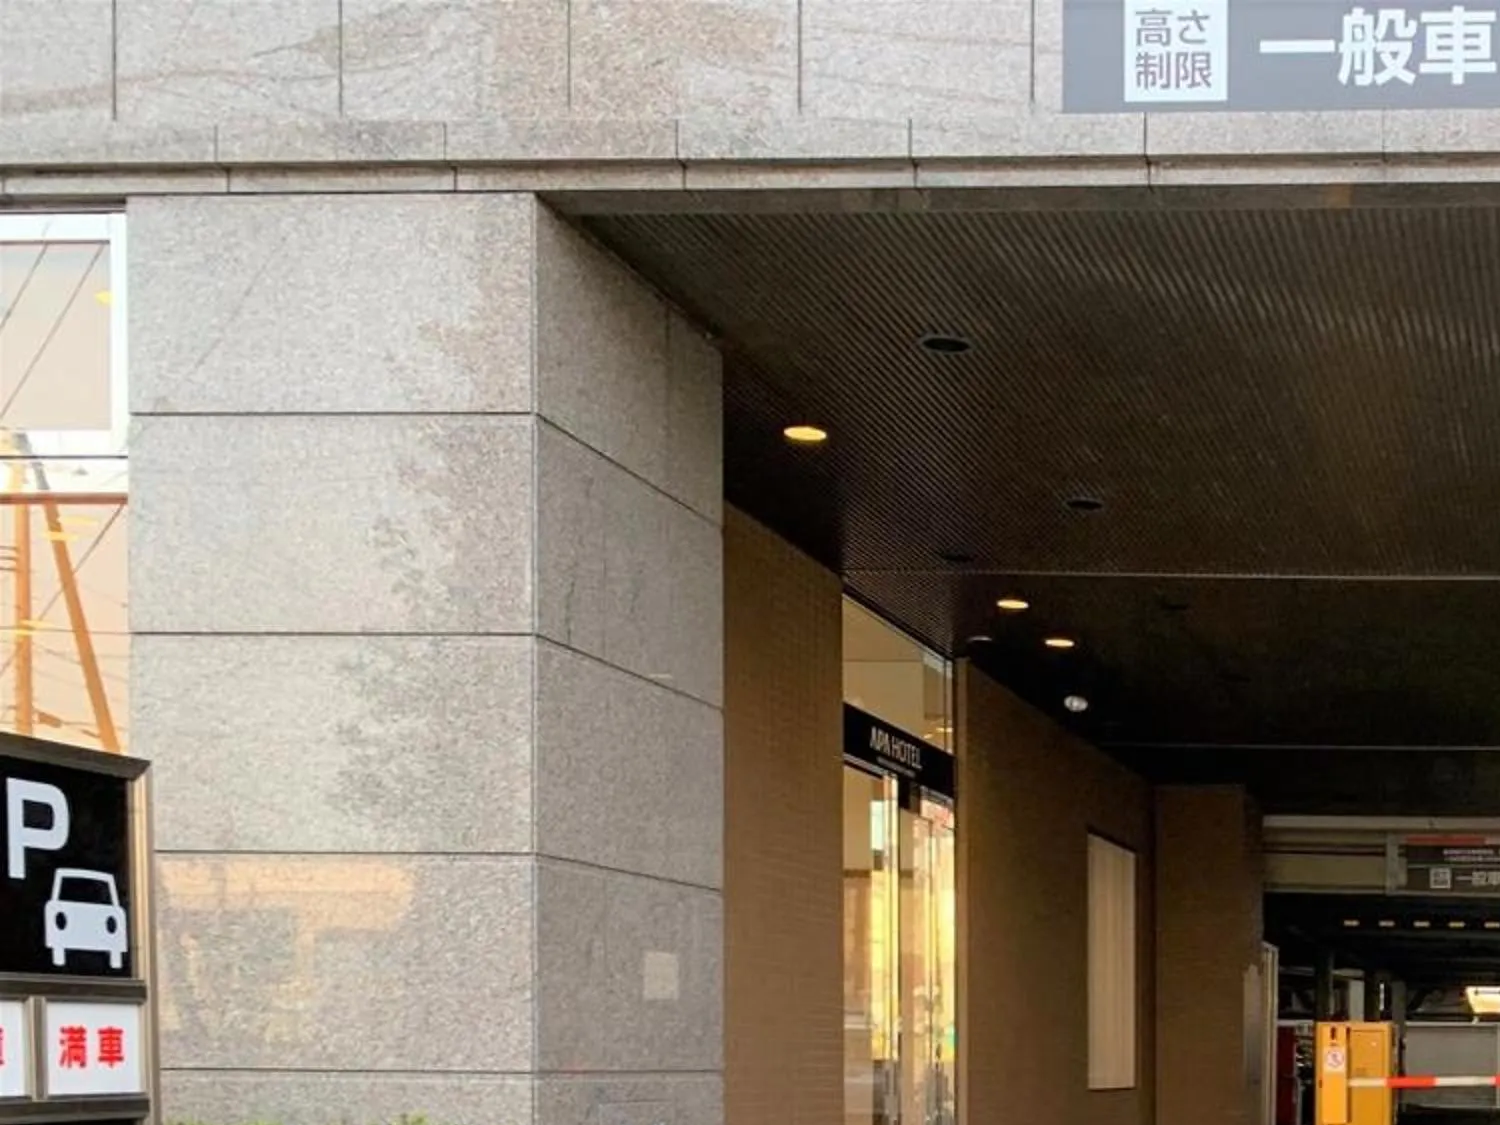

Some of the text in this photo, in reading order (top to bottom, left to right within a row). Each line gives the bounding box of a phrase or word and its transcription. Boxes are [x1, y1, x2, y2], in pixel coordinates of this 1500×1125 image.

[1135, 8, 1210, 46] 高さ
[1259, 6, 1497, 86] 一般車
[1135, 51, 1212, 90] 制限
[6, 777, 70, 880] P
[59, 1025, 125, 1068] 満車
